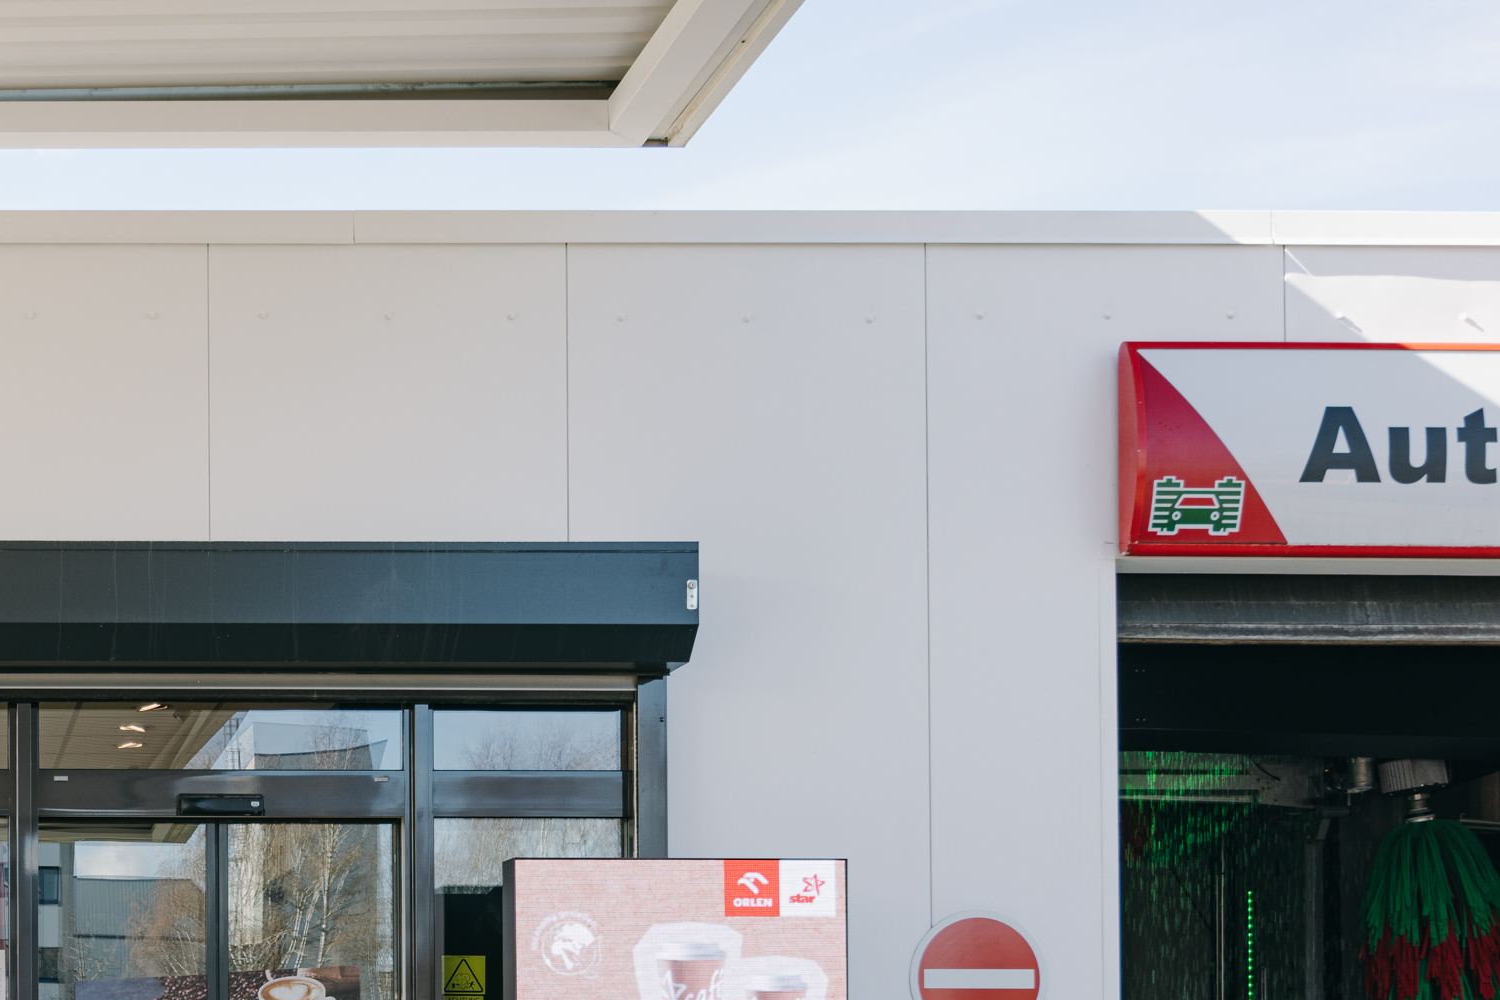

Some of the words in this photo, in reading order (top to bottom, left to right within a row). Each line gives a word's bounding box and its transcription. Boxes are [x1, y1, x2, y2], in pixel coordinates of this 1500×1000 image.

[1298, 405, 1498, 486] Aut
[733, 897, 773, 908] ORLEN
[788, 893, 817, 904] star
